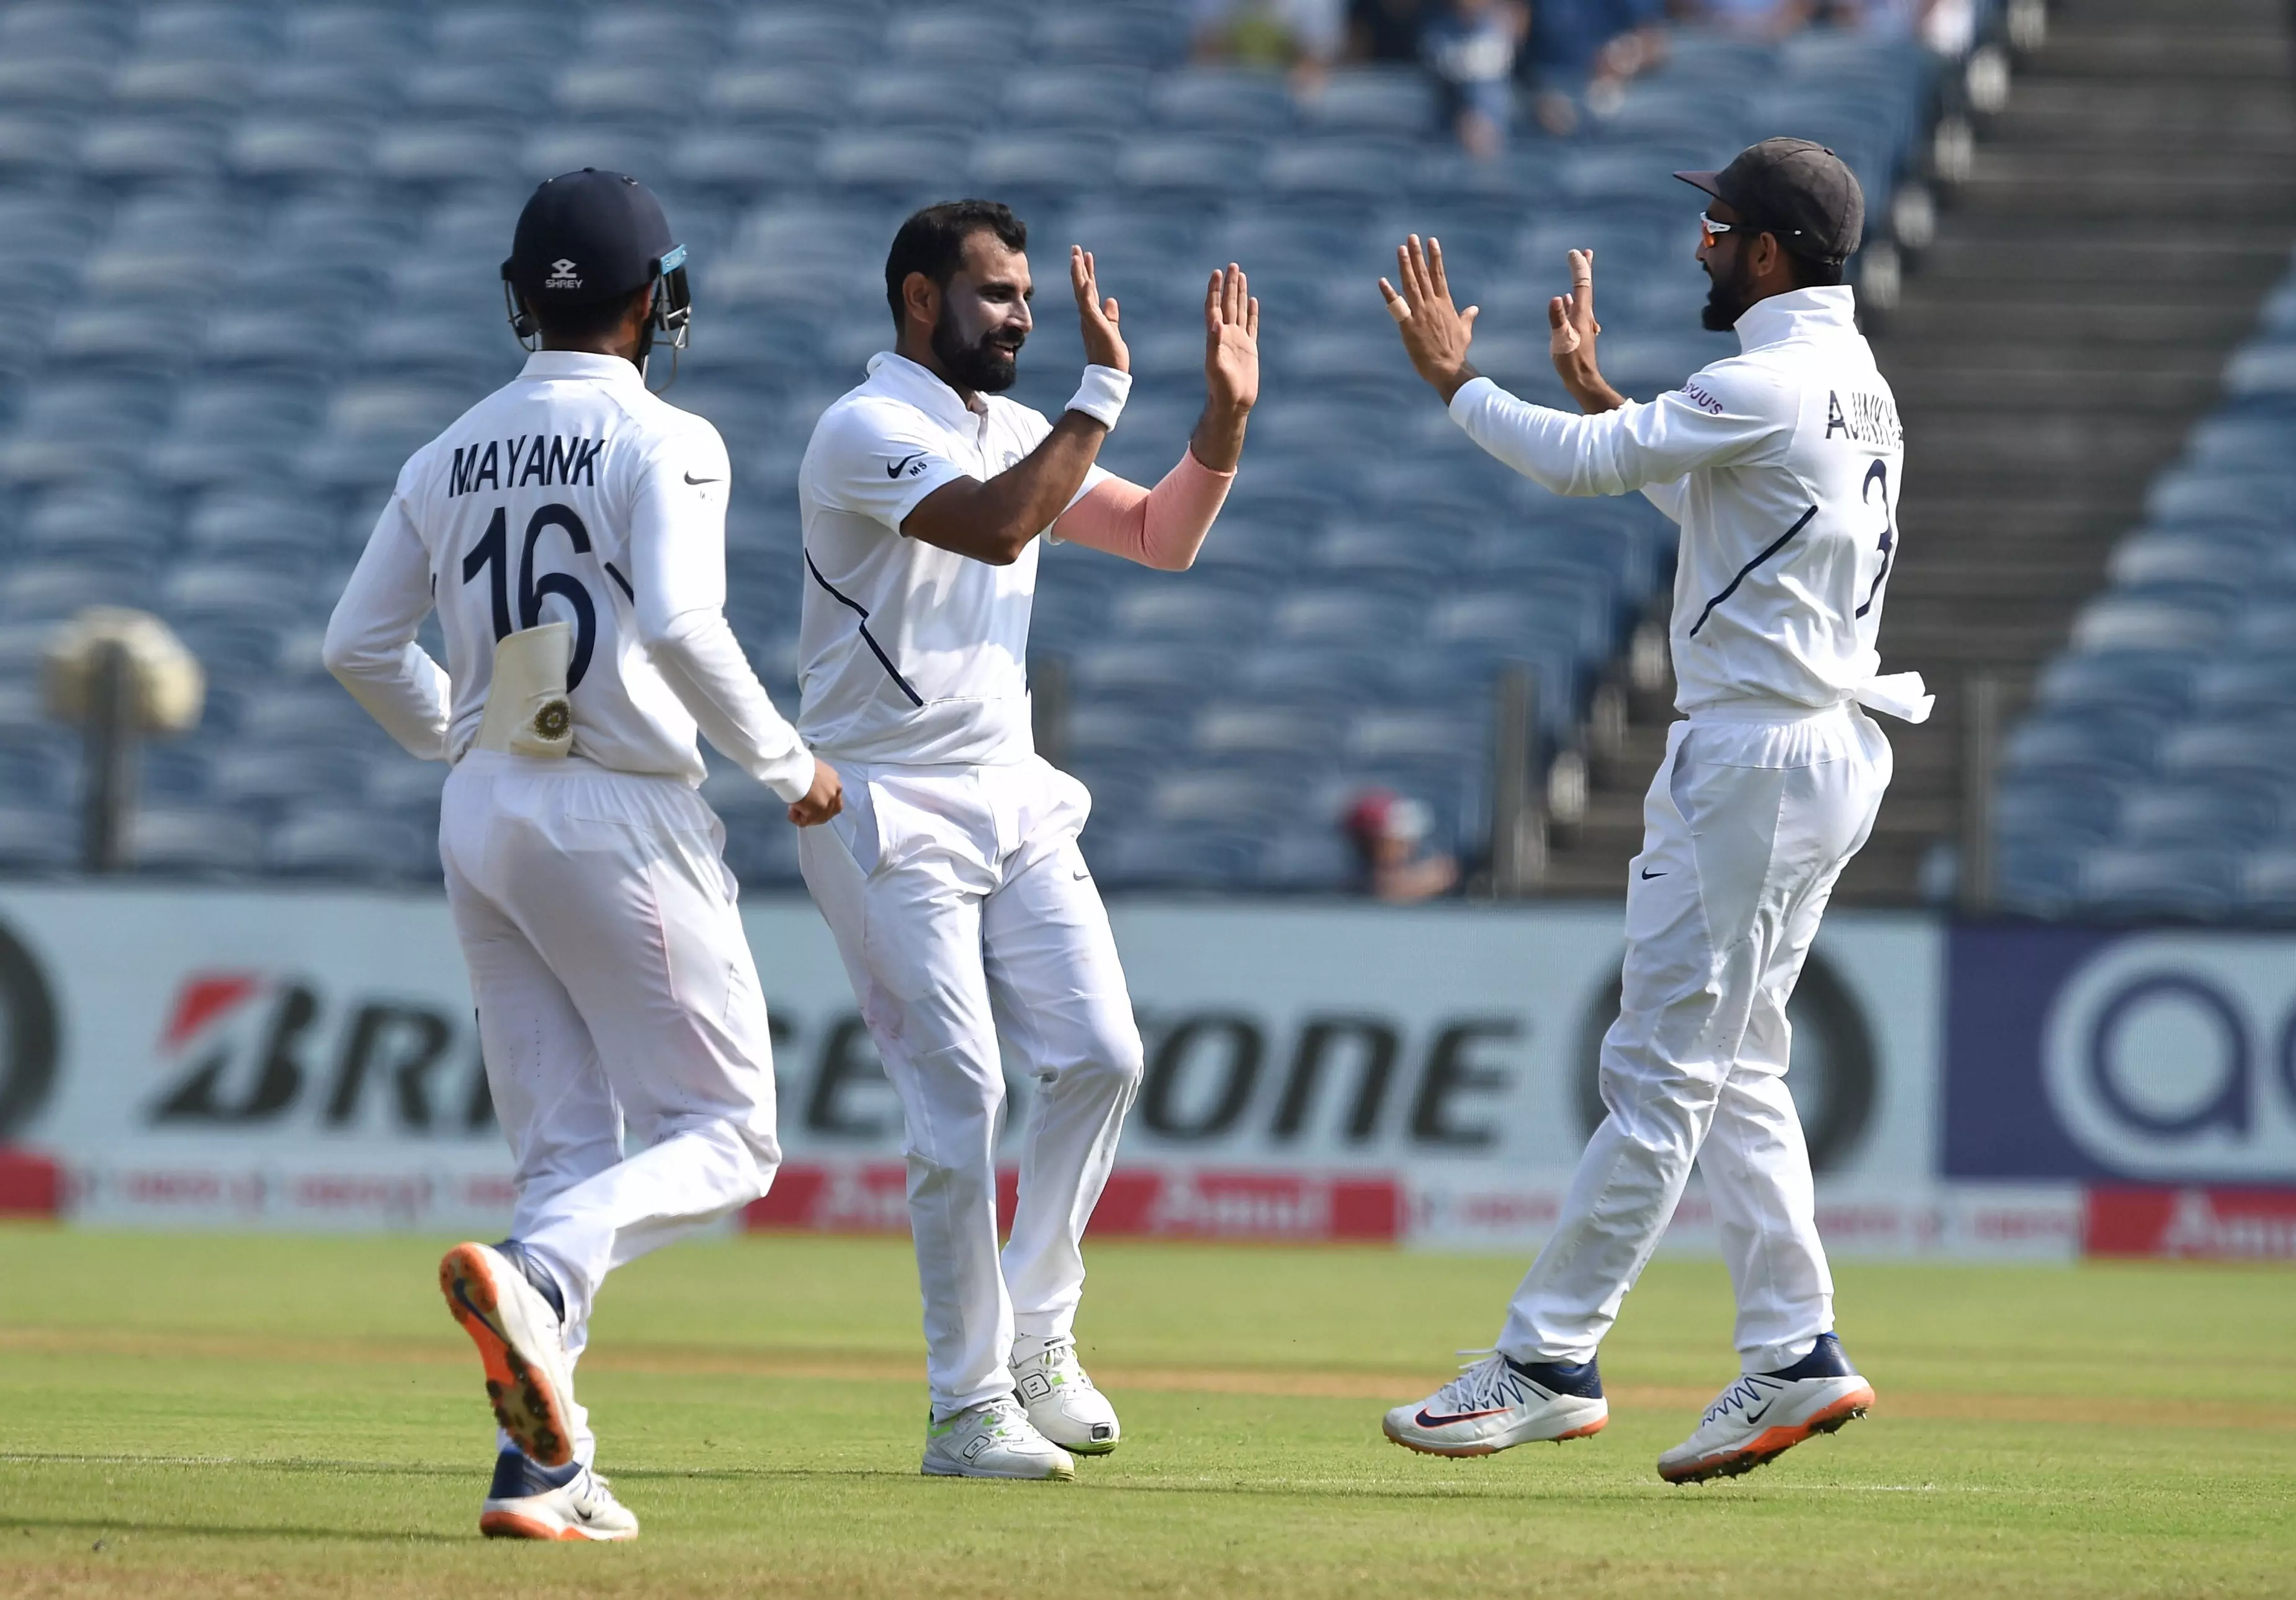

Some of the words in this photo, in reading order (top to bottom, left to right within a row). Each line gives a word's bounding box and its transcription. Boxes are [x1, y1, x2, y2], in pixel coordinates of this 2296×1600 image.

[545, 279, 583, 288] SHREY
[448, 434, 606, 498] MAYANK
[909, 462, 927, 477] MS
[1856, 458, 1893, 620] 3
[462, 503, 596, 695] 16
